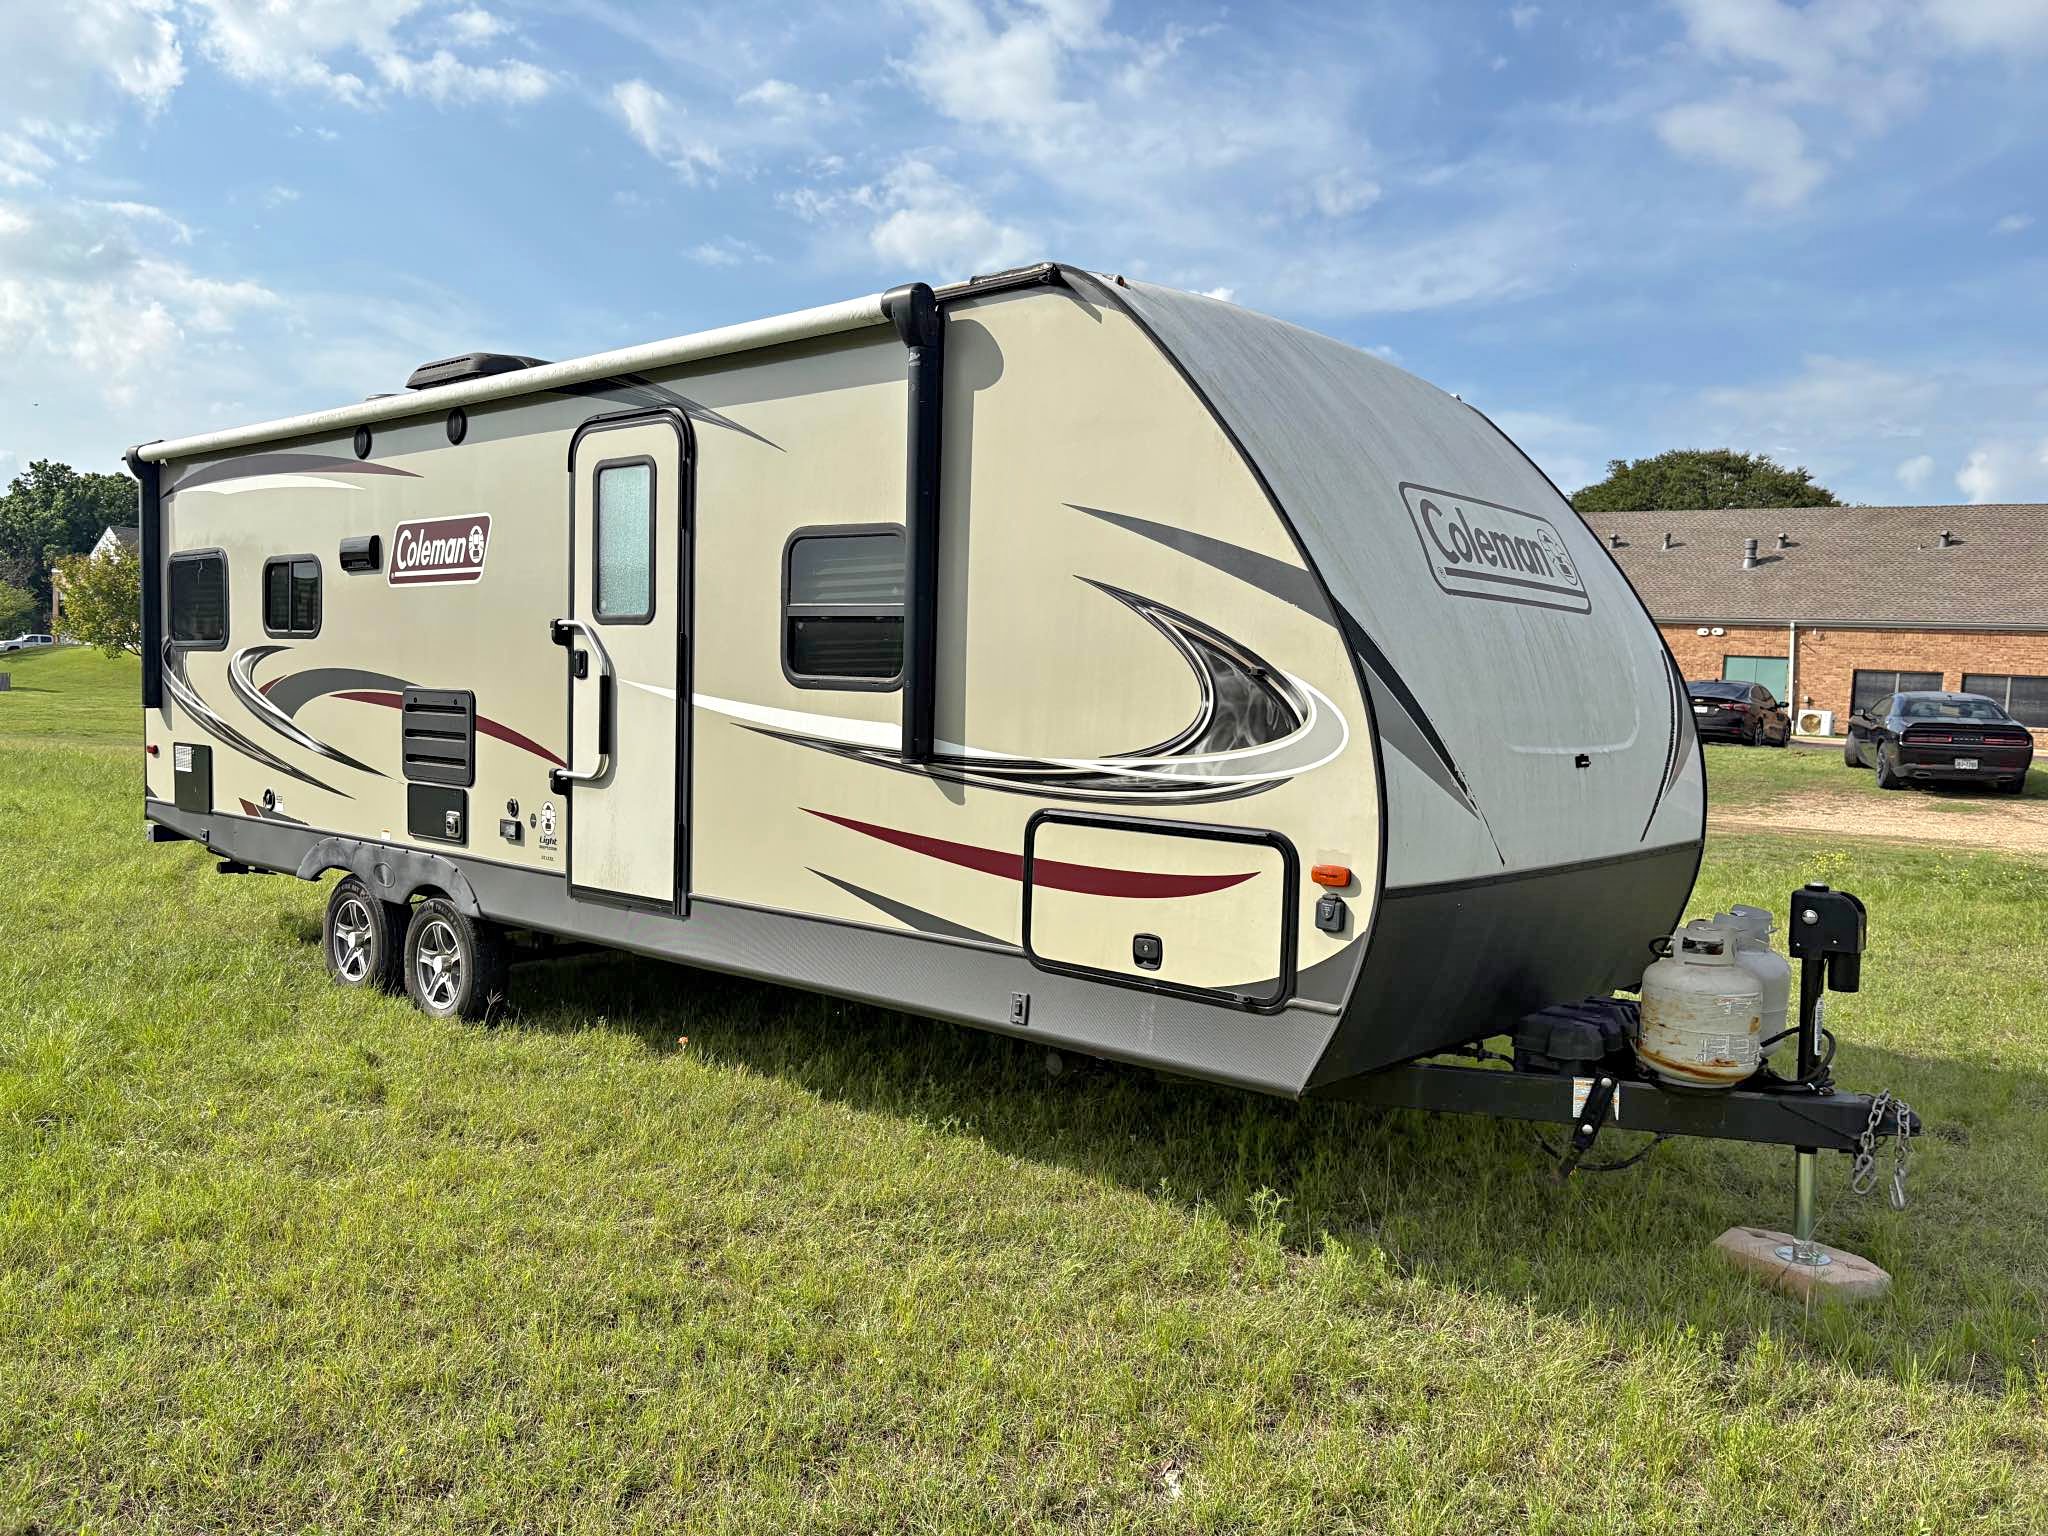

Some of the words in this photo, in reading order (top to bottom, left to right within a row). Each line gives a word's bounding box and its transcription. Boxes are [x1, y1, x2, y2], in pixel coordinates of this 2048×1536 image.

[397, 528, 467, 570] Coleman
[1420, 499, 1555, 578] Coleman
[539, 835, 558, 846] Light
